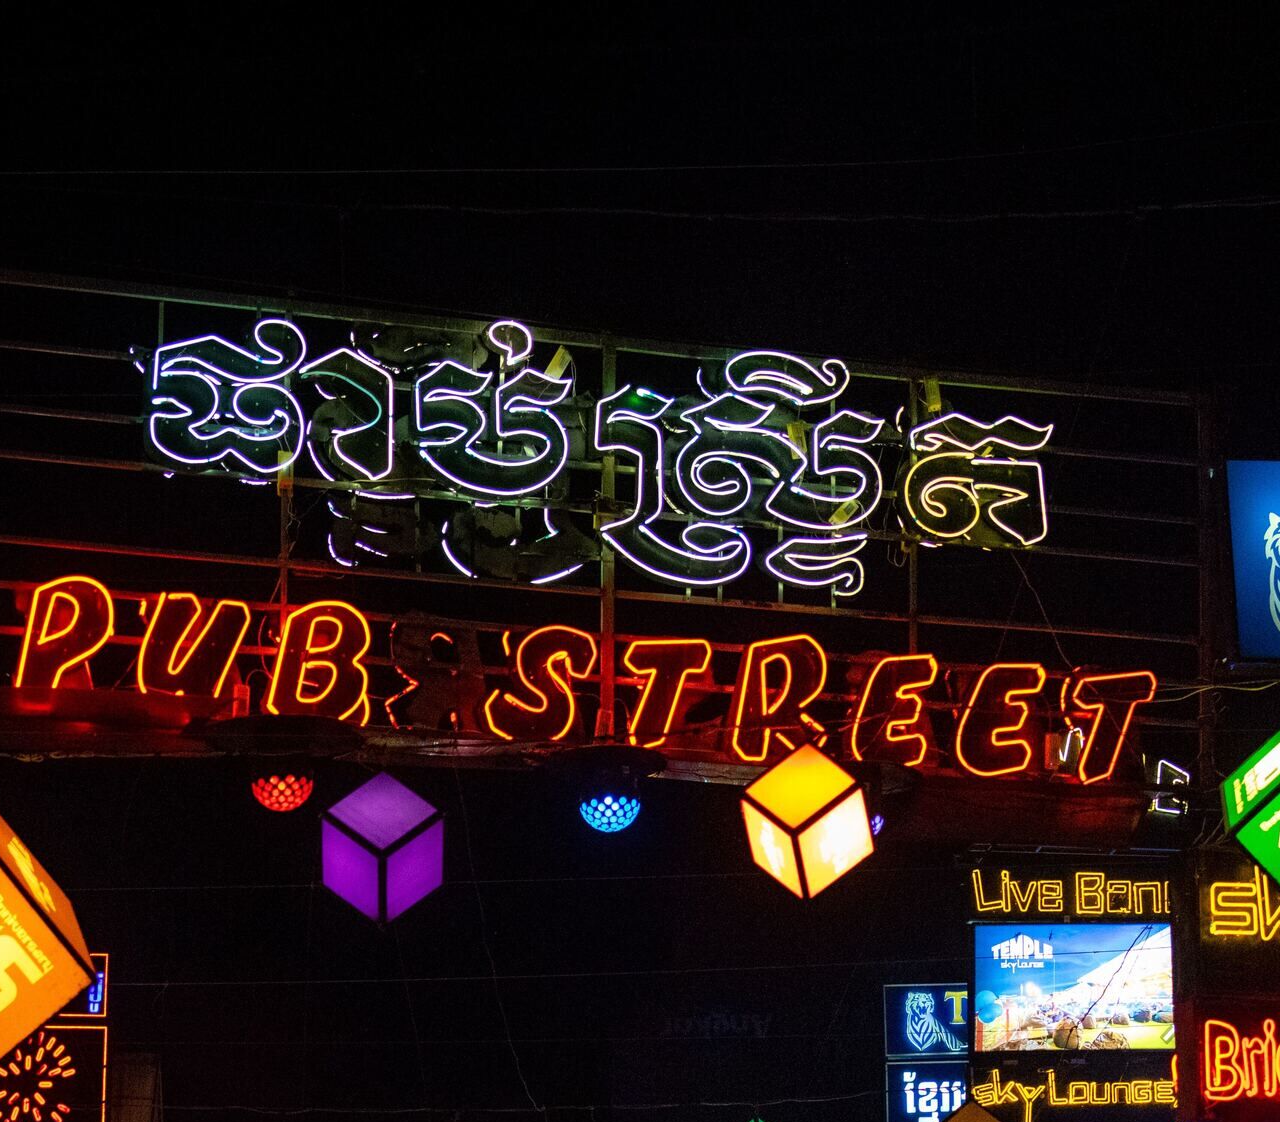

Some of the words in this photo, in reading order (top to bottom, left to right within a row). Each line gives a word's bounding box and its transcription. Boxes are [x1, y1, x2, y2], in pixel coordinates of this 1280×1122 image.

[13, 573, 371, 727] PUB
[484, 622, 1157, 786] STREET
[972, 869, 1063, 913] Live
[1076, 871, 1172, 914] Ban
[991, 934, 1054, 960] TEMPLE
